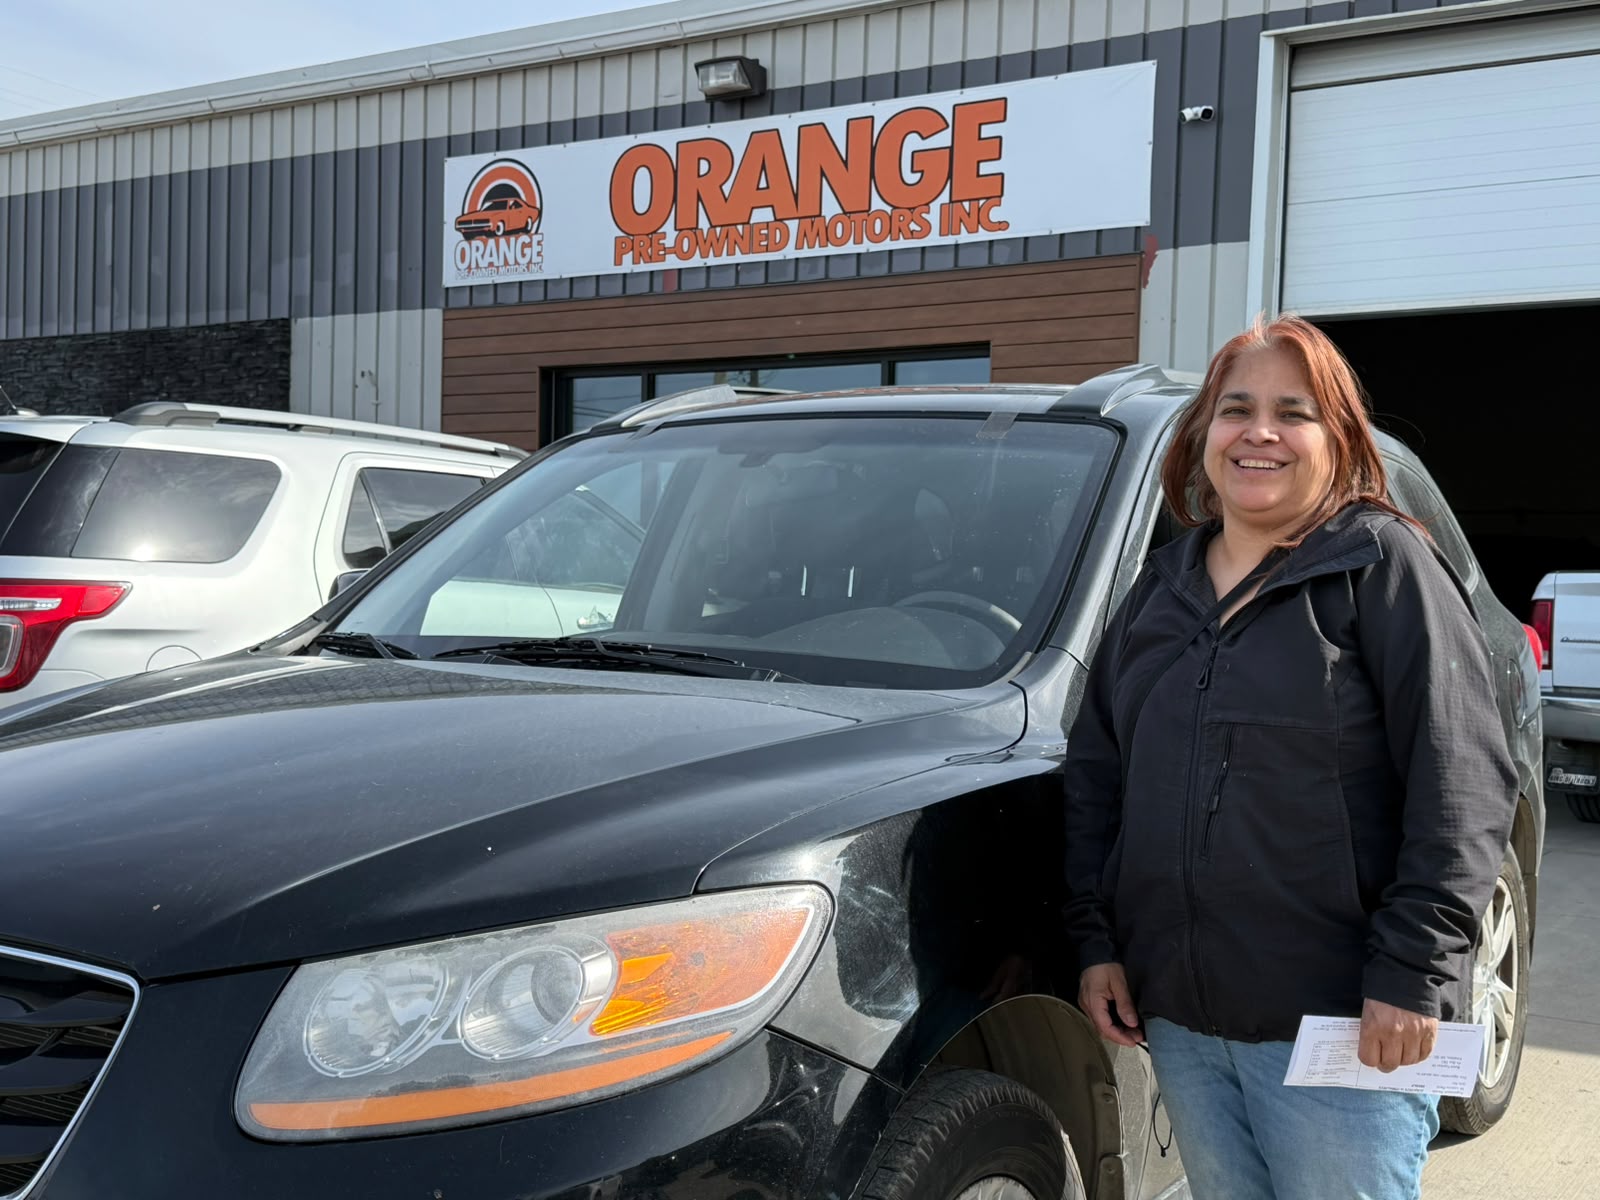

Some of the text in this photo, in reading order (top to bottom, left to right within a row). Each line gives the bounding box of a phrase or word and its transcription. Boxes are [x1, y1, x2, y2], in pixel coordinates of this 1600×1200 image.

[609, 97, 1008, 236] ORANGE
[454, 233, 544, 272] ORANGE
[613, 197, 1010, 266] PRE-OWNED MOTORS INC.
[498, 264, 528, 276] MOTORS
